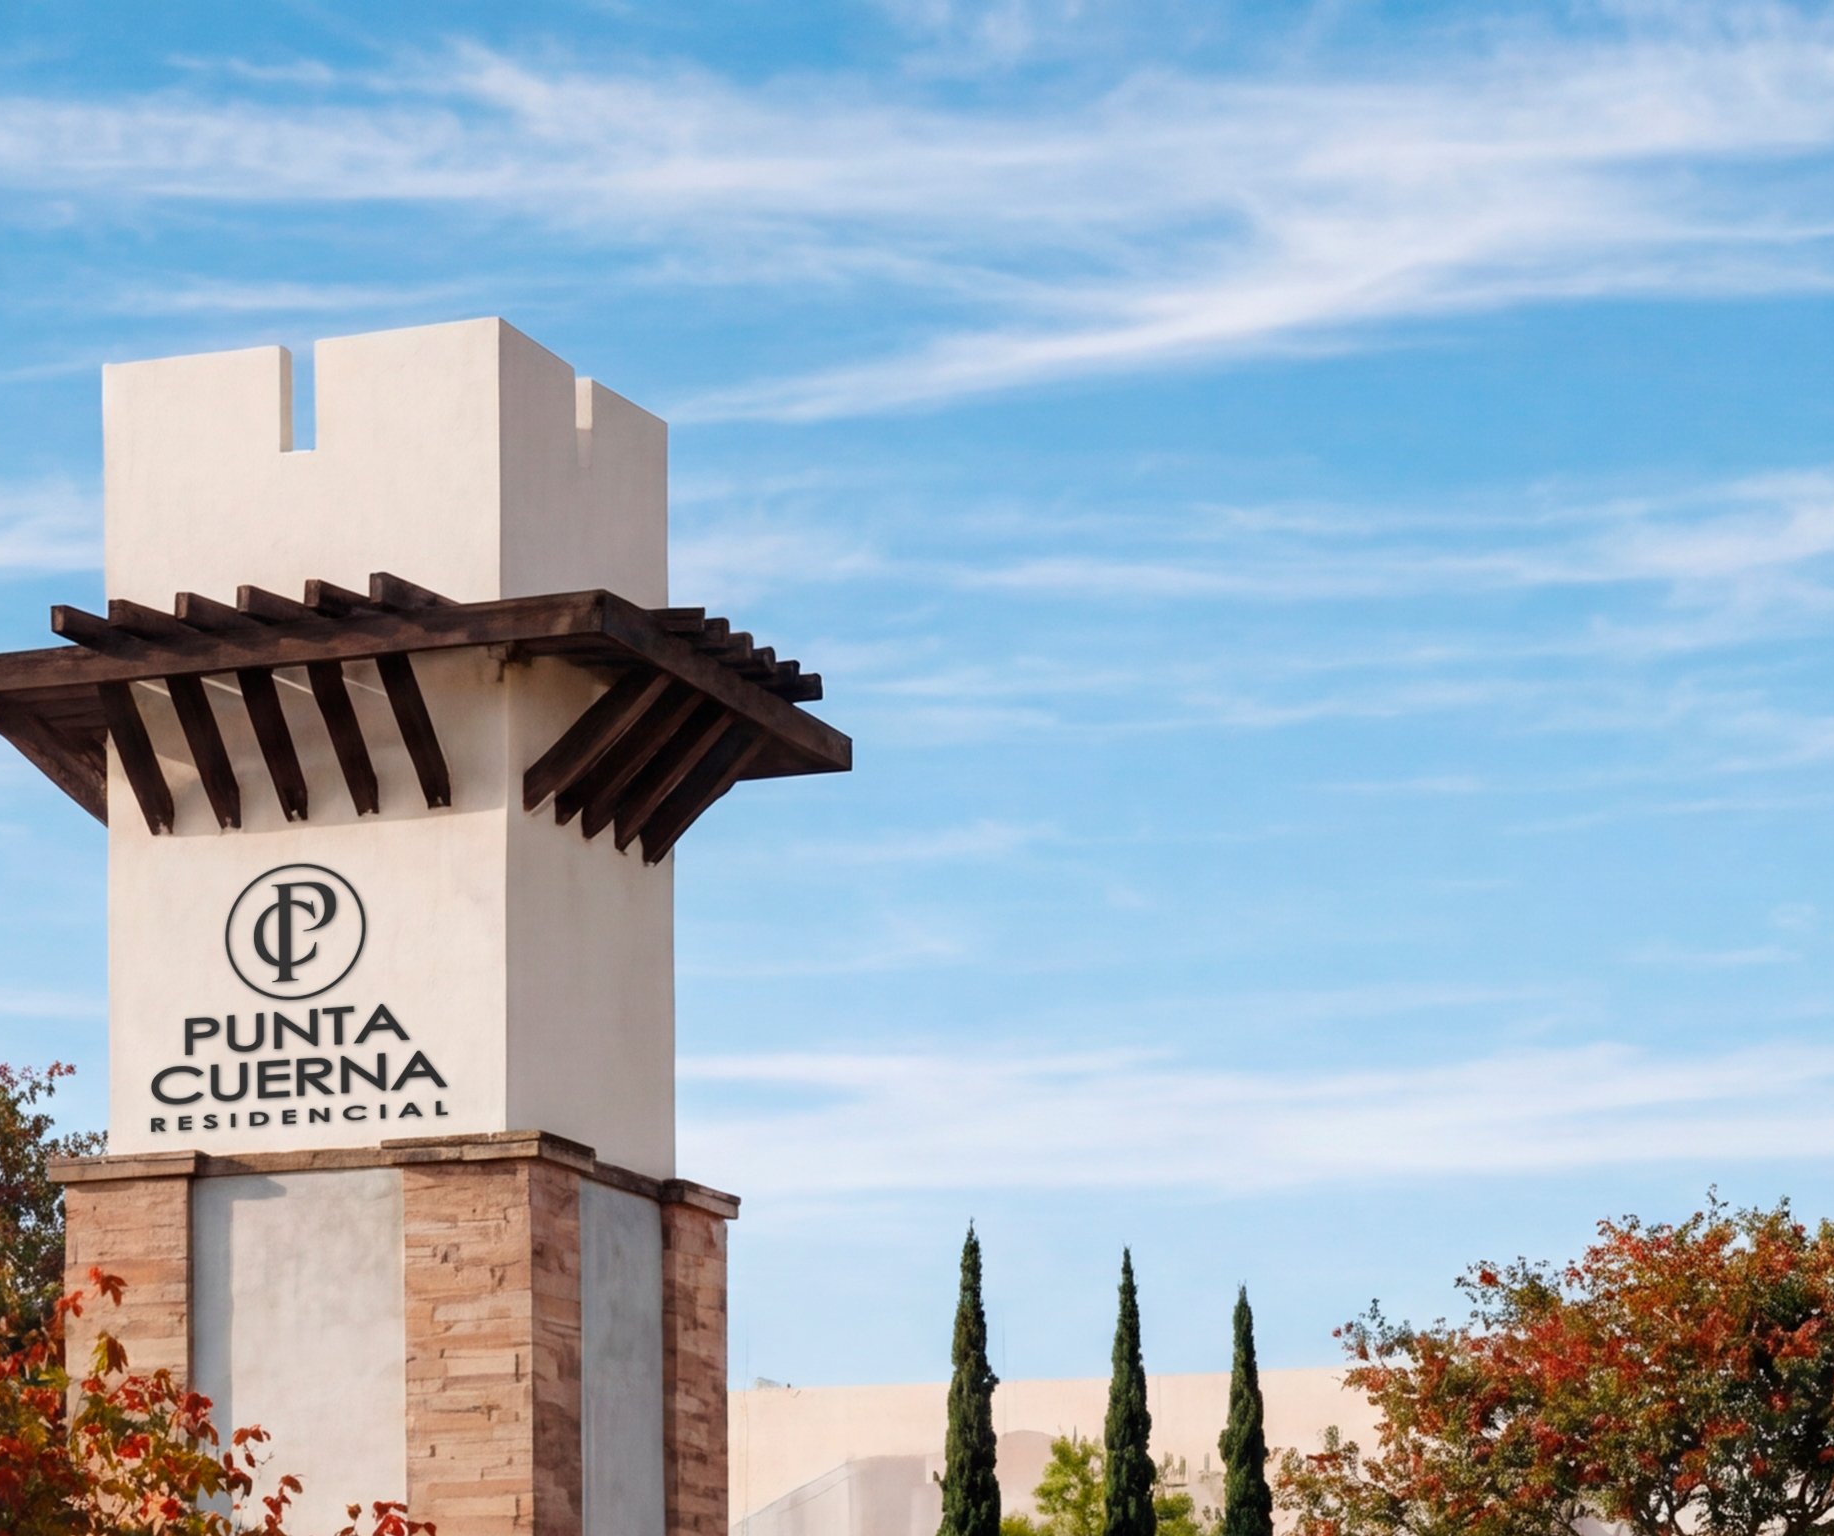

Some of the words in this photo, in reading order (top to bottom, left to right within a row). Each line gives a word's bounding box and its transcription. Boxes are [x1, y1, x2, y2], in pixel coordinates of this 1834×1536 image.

[183, 1003, 411, 1056] PUNTA
[150, 1049, 448, 1106] CUERNA
[150, 1100, 450, 1133] RESIDENCIAL
